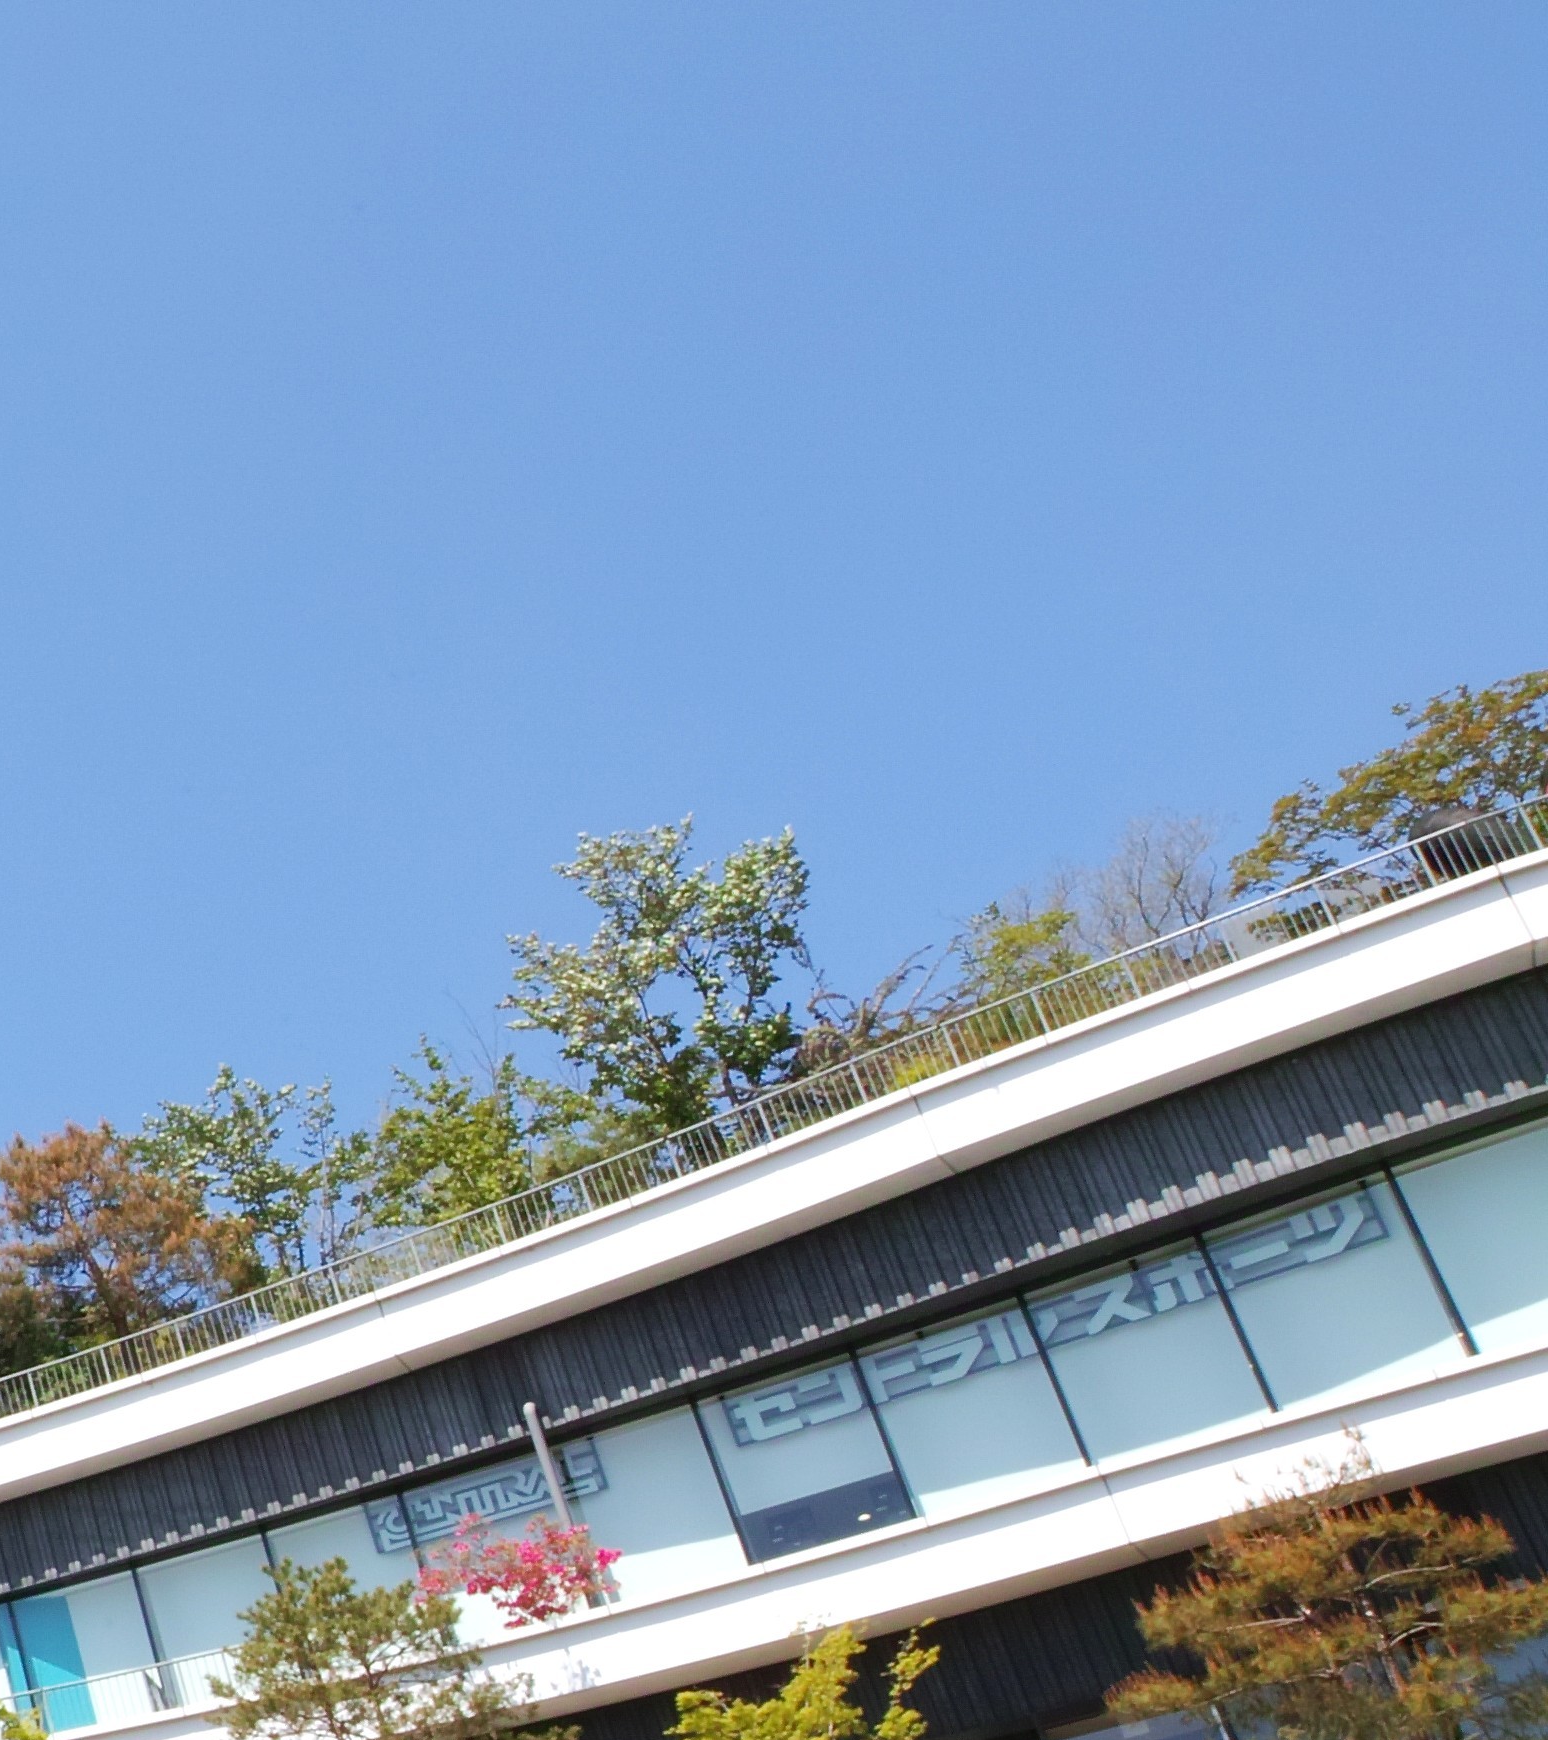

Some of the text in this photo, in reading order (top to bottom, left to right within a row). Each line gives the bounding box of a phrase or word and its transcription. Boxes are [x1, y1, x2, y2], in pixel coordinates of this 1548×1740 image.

[734, 1198, 1368, 1442] セントラルスポーツ
